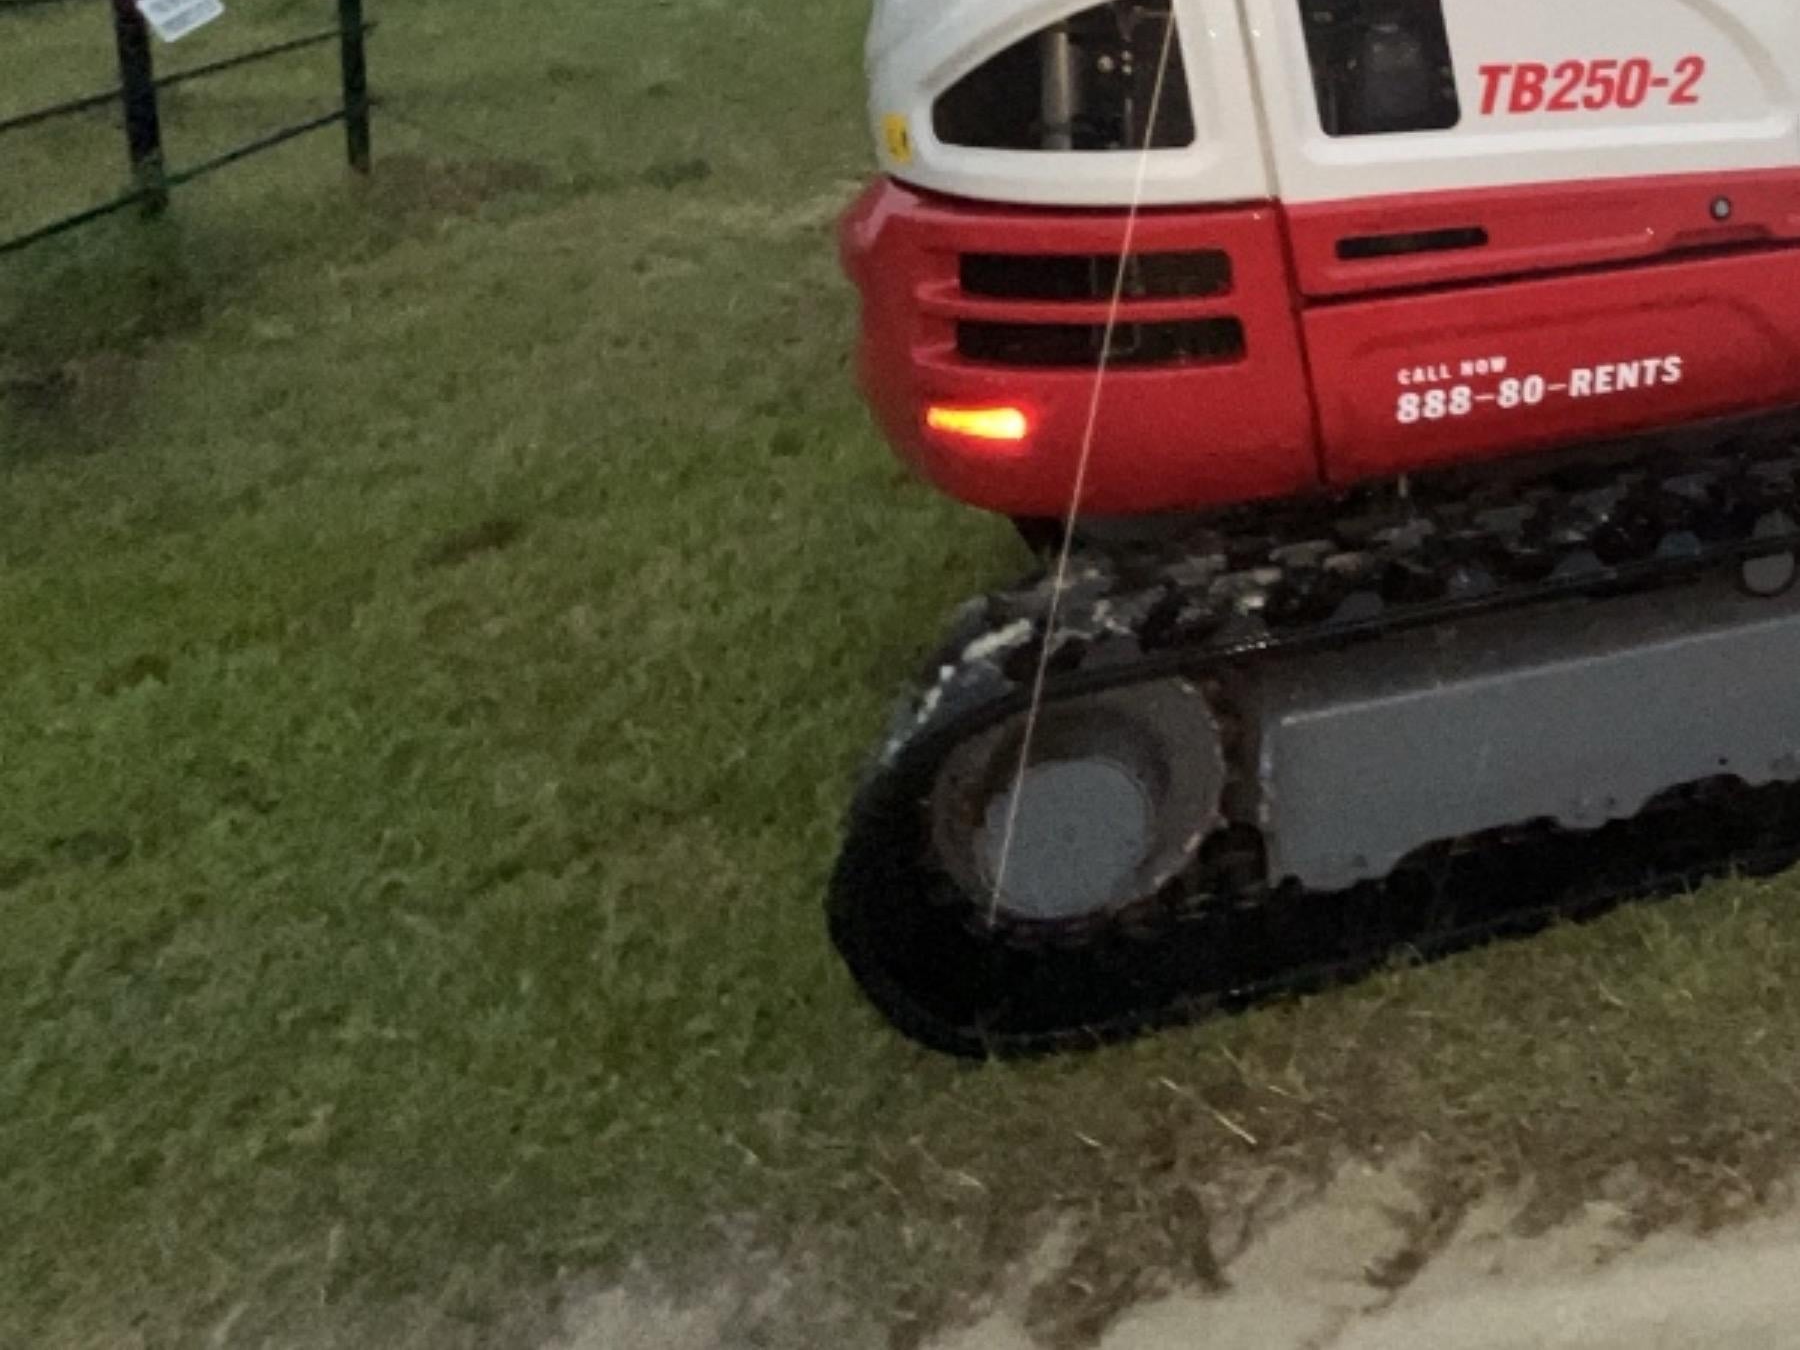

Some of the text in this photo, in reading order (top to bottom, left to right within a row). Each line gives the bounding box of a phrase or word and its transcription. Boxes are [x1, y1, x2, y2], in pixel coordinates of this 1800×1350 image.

[1478, 55, 1706, 115] TB250-2
[1397, 356, 1507, 385] CALL NOW
[1397, 356, 1683, 423] 888-80-RENTS
